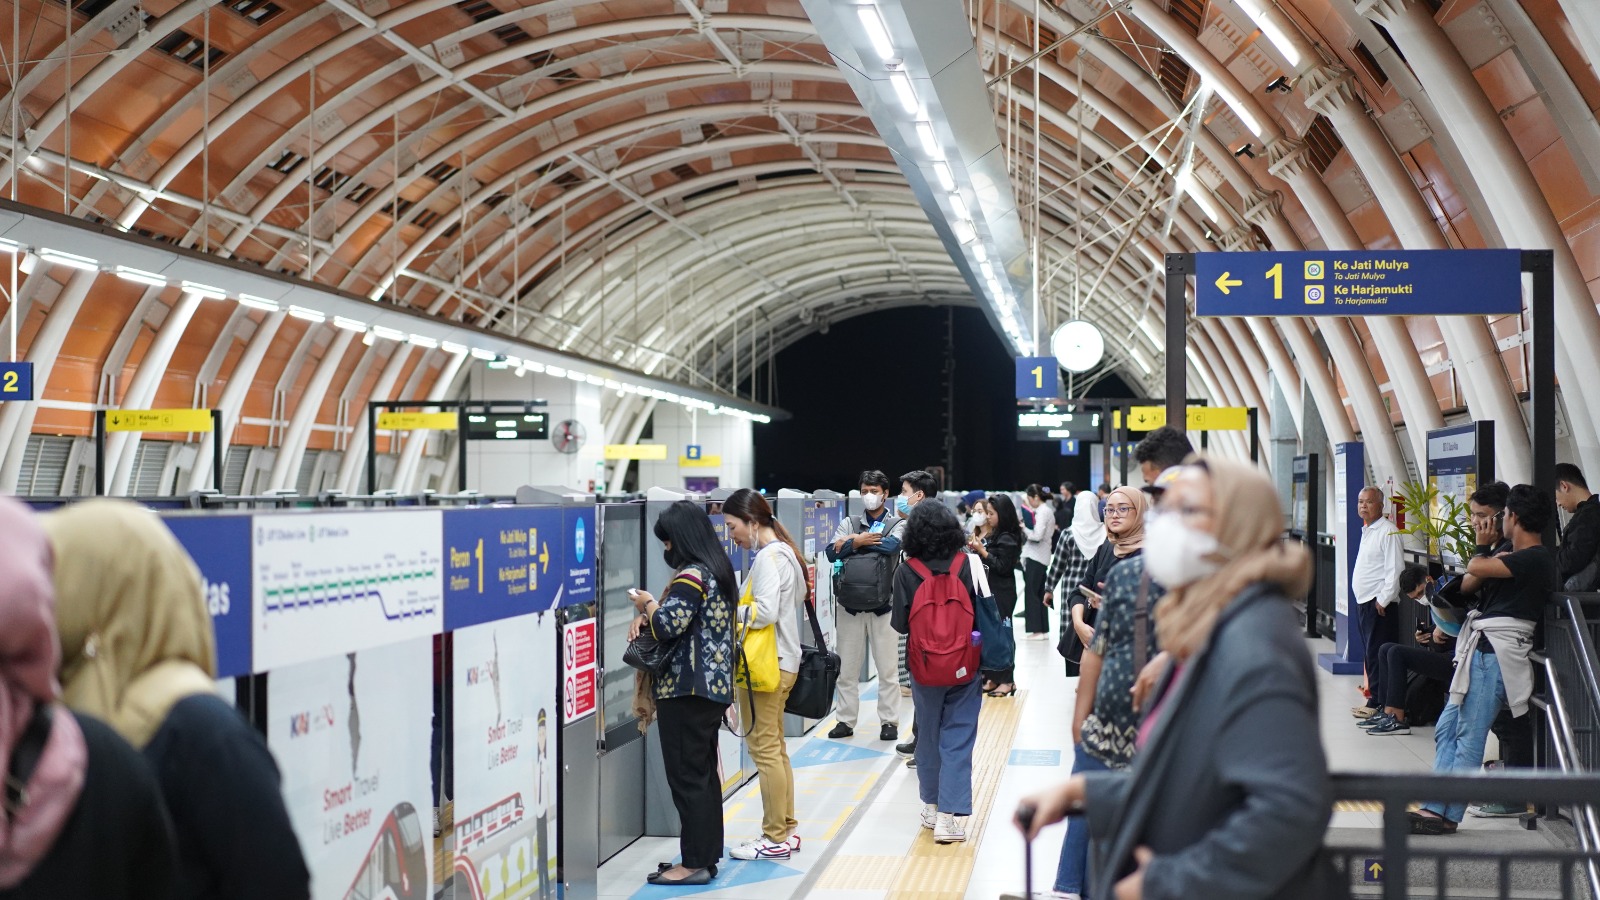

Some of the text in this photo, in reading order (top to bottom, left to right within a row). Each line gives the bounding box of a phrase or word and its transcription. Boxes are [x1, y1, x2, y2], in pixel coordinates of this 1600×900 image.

[1333, 260, 1409, 271] Ke Jati Mulya
[1265, 263, 1283, 300] 1
[1344, 272, 1359, 280] Jati
[1361, 272, 1386, 281] Mulya
[1333, 284, 1413, 296] Ke Harjamukti
[1334, 296, 1388, 306] To Harjamukti
[3, 371, 19, 393] 2
[1031, 366, 1042, 389] 1
[689, 447, 698, 458] 2
[1067, 441, 1074, 452] 1
[451, 547, 470, 568] Peron
[475, 538, 484, 594] 1
[488, 723, 506, 744] Smart
[500, 745, 518, 764] Better
[323, 782, 352, 812] Smart
[343, 808, 372, 836] Better
